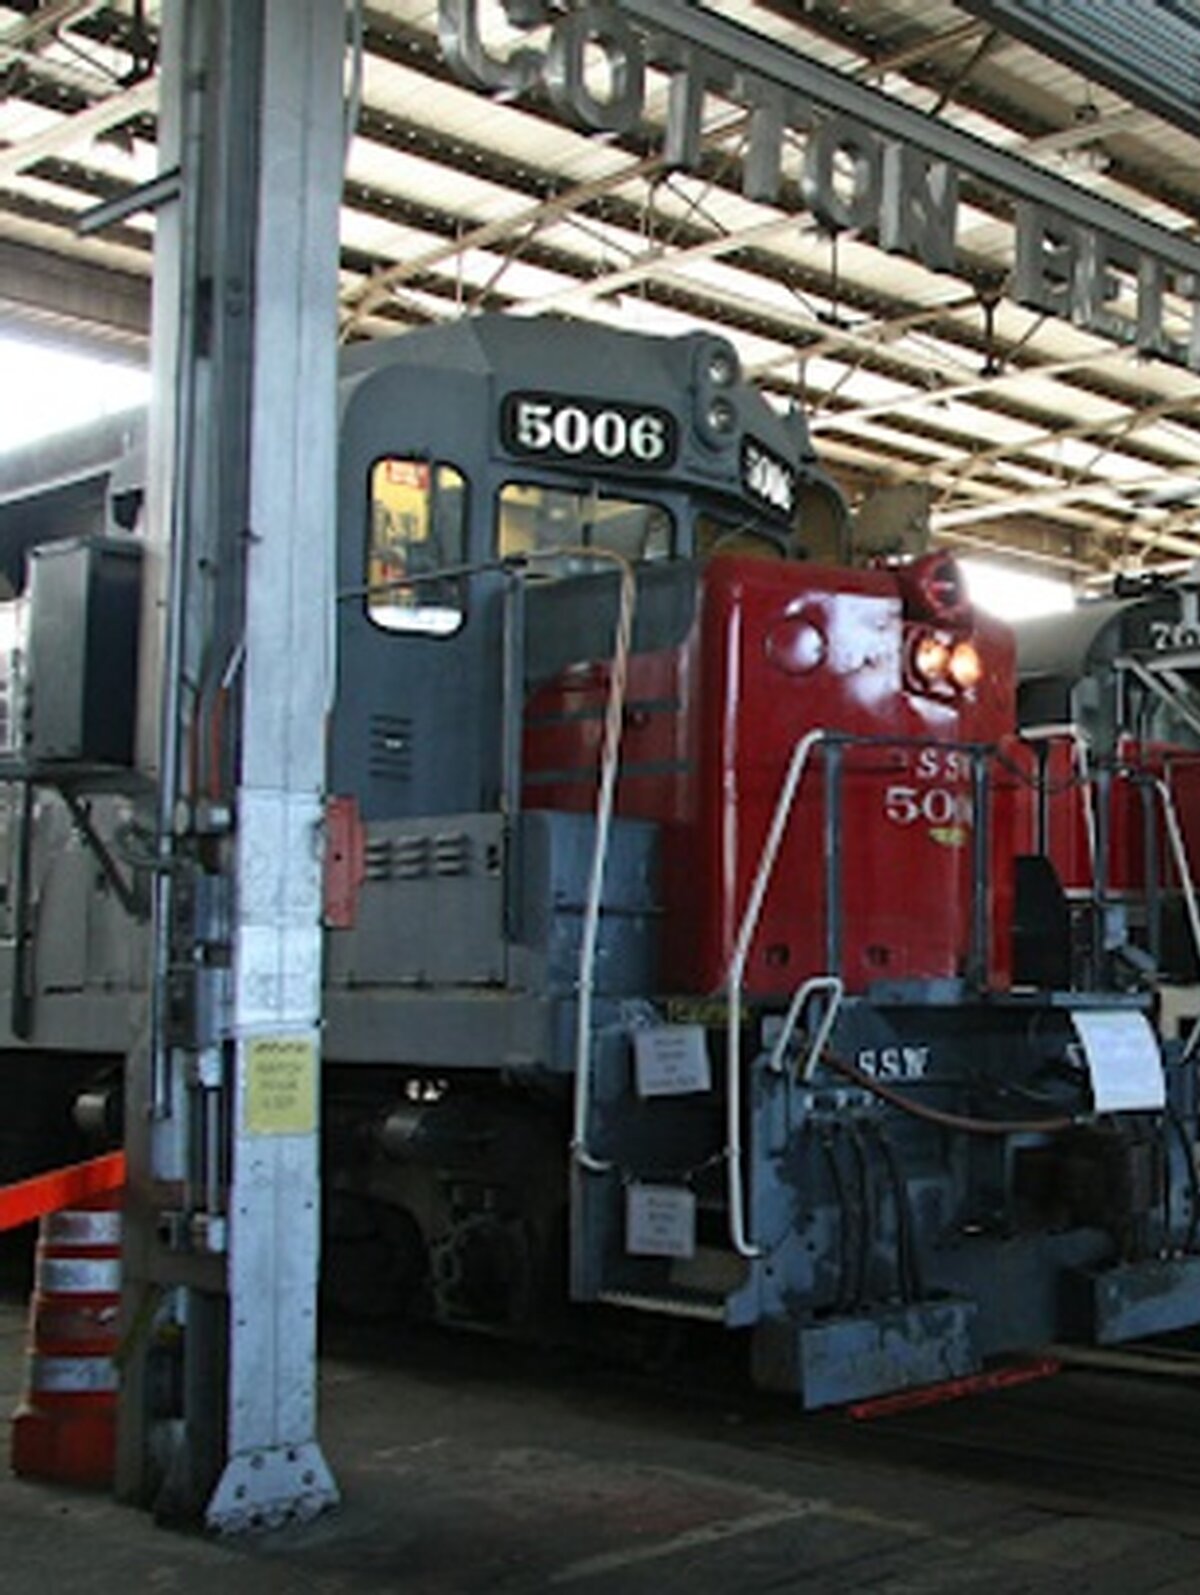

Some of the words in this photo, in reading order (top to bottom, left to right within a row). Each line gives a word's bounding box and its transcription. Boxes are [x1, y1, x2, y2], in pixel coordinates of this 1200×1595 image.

[438, 0, 958, 271] COTTON
[516, 402, 666, 459] 5006
[859, 1046, 930, 1079] SSW
